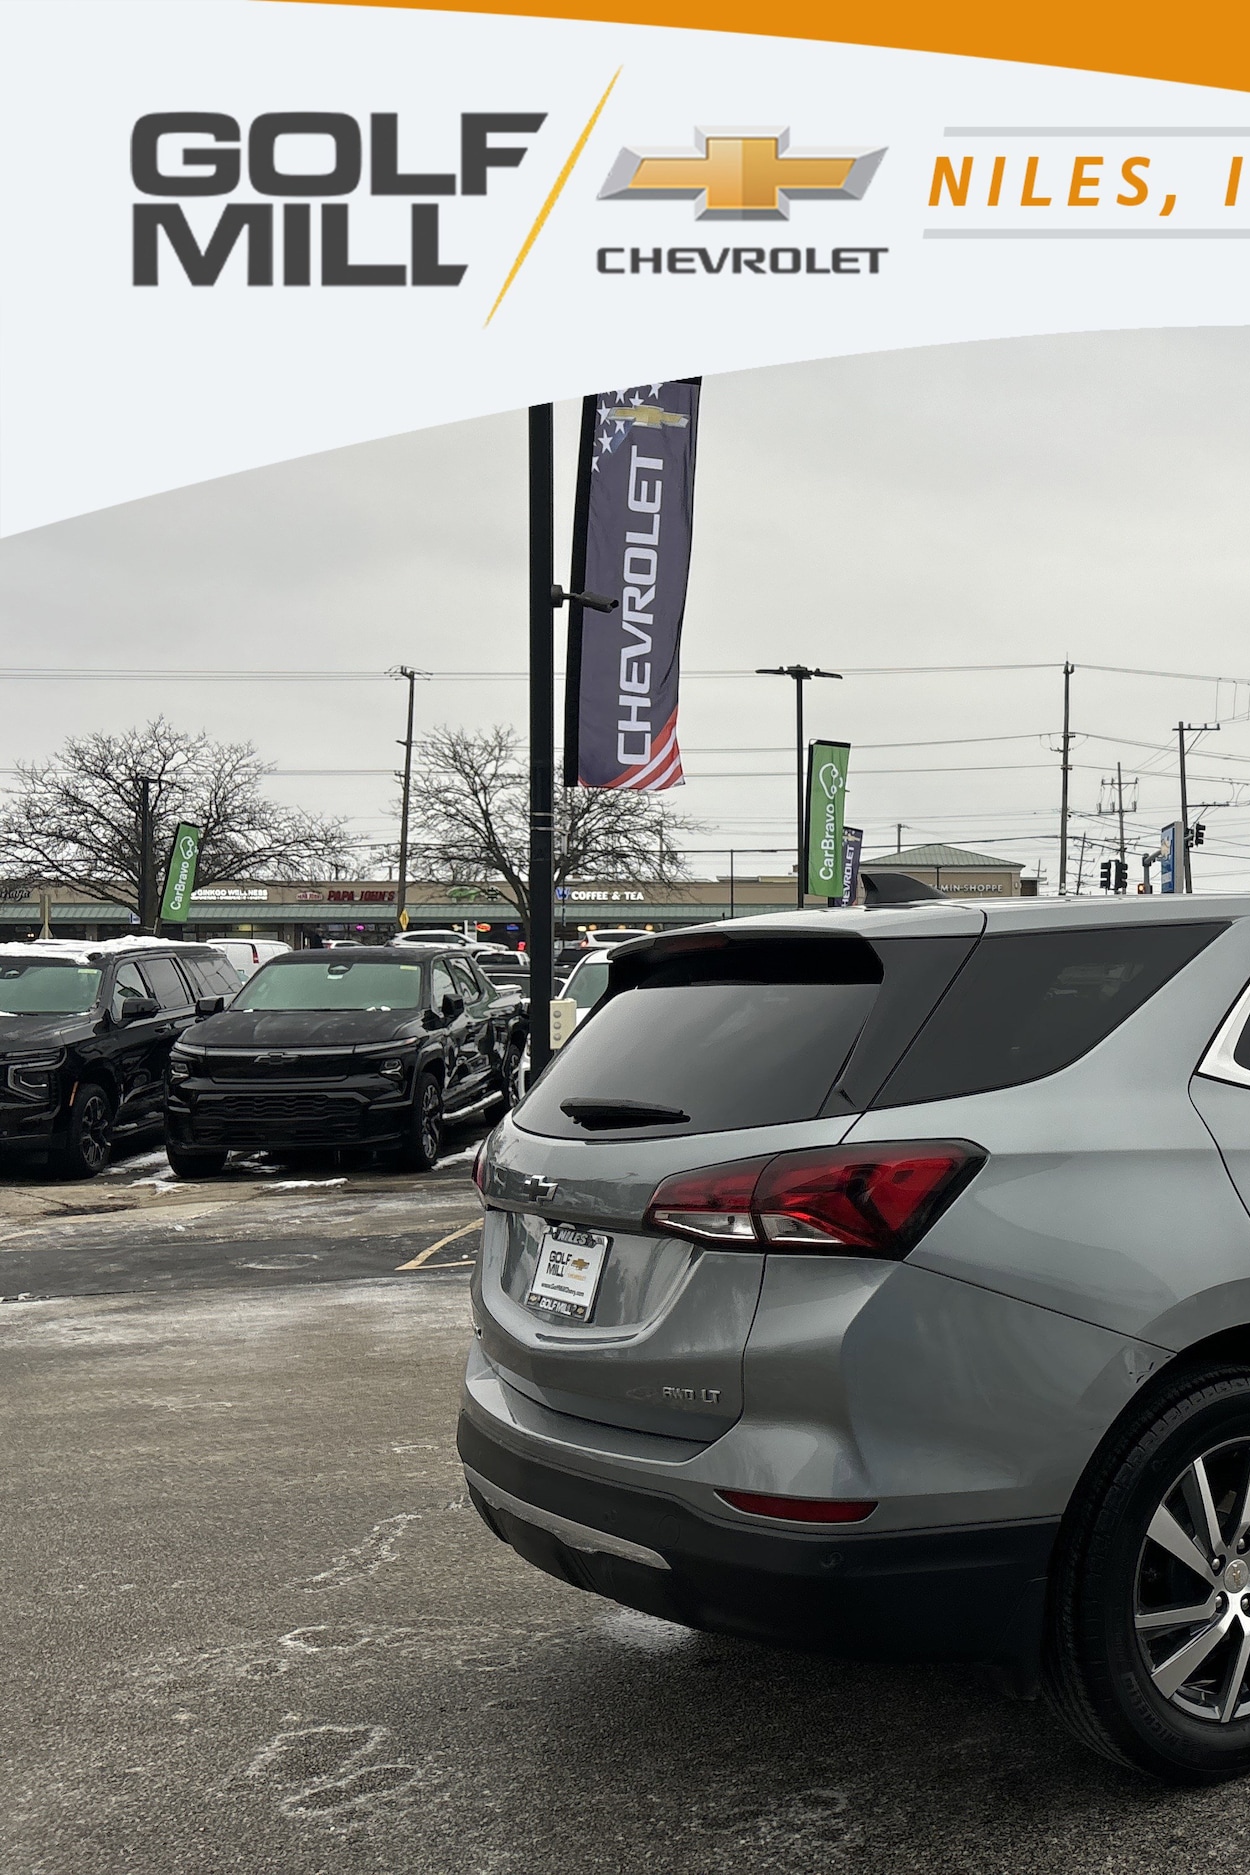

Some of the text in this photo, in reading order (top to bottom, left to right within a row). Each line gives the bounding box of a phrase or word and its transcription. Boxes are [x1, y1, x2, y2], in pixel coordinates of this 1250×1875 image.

[616, 444, 665, 766] CHEVROLET
[819, 803, 835, 881] CarBravo
[841, 845, 855, 907] HEVROLET
[170, 861, 190, 911] CarBravo
[327, 890, 355, 901] PAPA
[359, 890, 396, 901] JOHN'S
[571, 891, 609, 901] COFFEE
[612, 891, 621, 901] &
[624, 891, 645, 901] TEA
[557, 1230, 589, 1245] NILES
[548, 1250, 573, 1266] GOLF
[546, 1262, 565, 1278] MILL
[539, 1297, 558, 1311] GOLF
[662, 1385, 721, 1404] AWD LT
